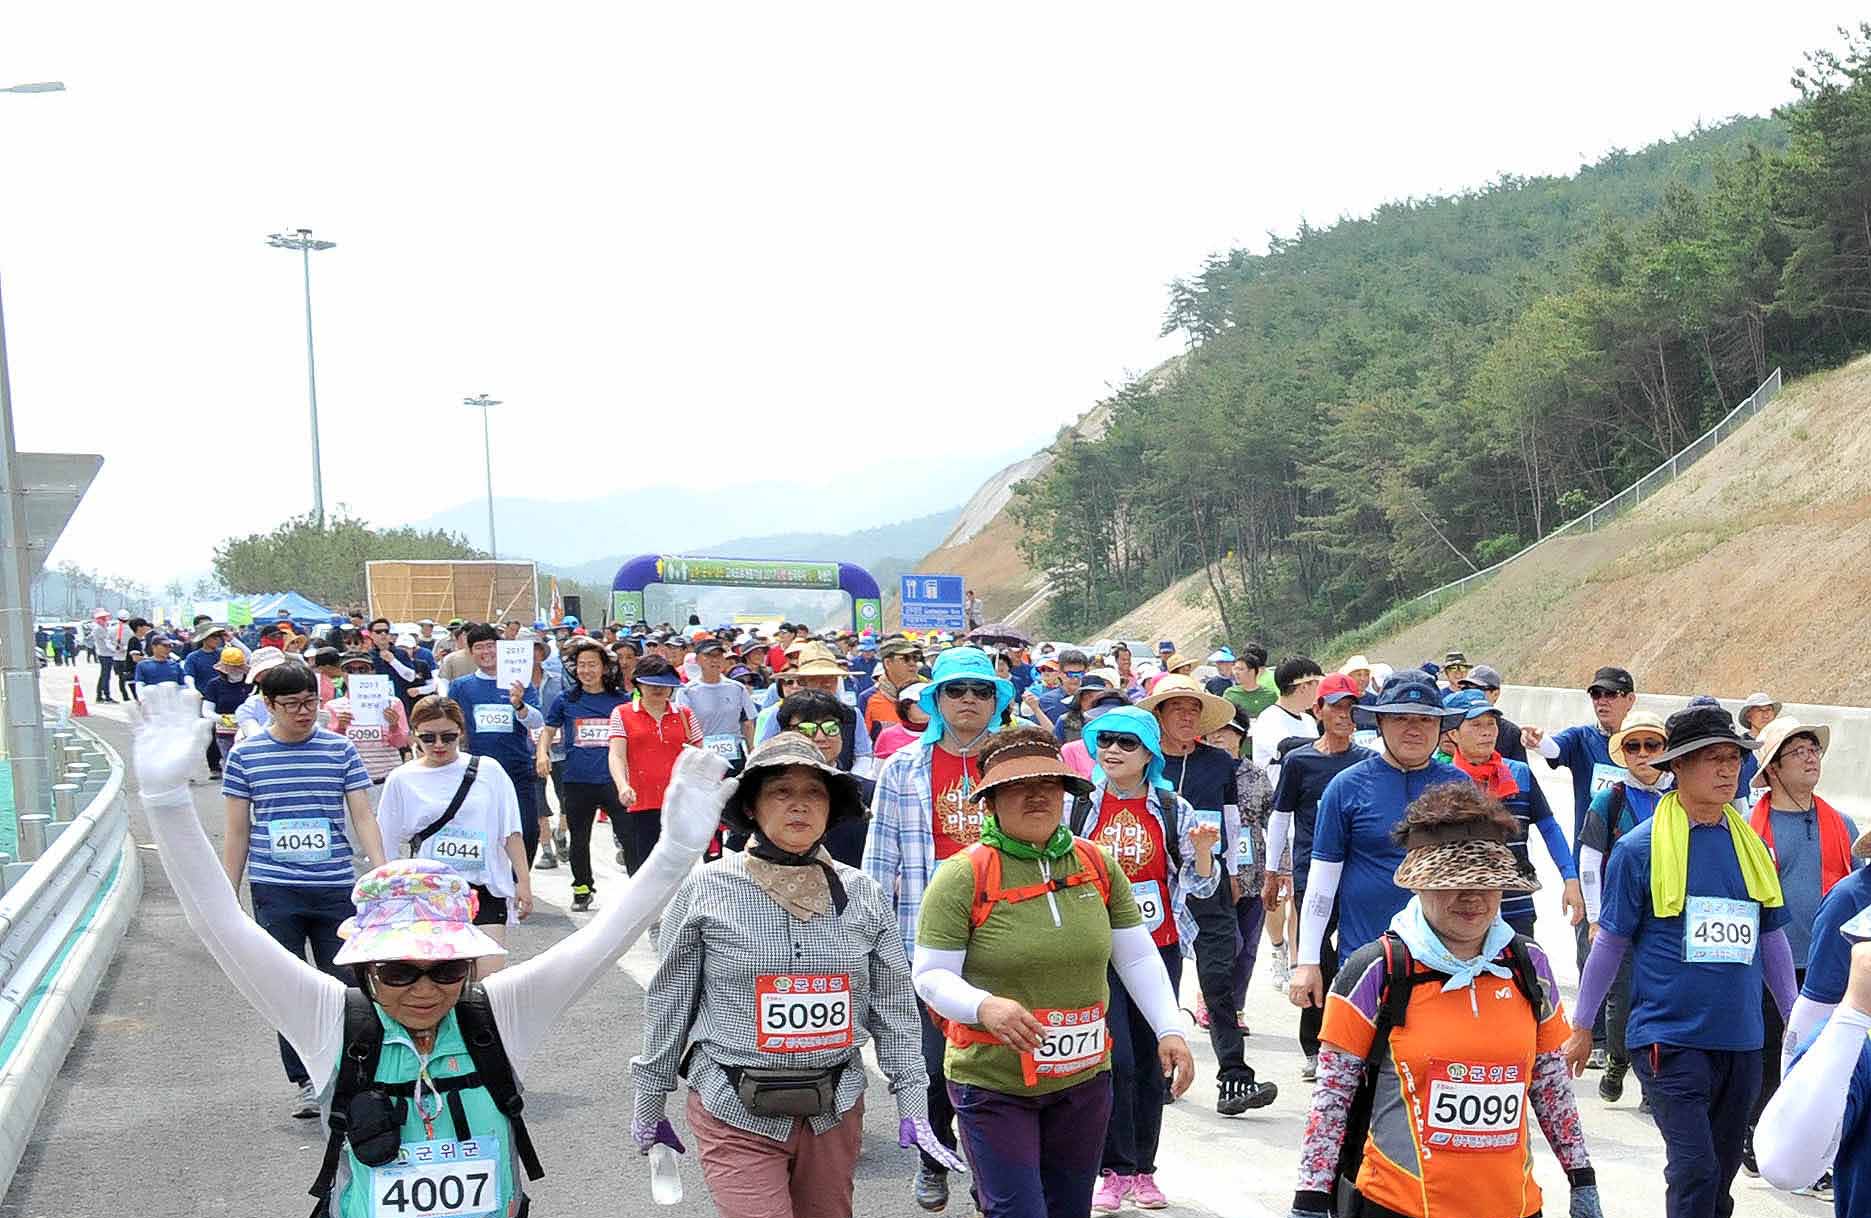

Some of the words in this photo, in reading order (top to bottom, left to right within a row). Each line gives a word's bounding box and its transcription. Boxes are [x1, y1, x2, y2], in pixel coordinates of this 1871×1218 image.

[479, 714, 509, 725] 7052
[347, 726, 380, 740] 5090
[276, 833, 326, 850] 4043
[435, 841, 481, 859] 4044
[1694, 921, 1752, 945] 4309
[766, 1000, 846, 1029] 5098
[1039, 1028, 1100, 1058] 5071
[1469, 1065, 1519, 1082] 군위군
[1434, 1092, 1520, 1126] 5099
[415, 1142, 480, 1162] 군위군
[381, 1172, 490, 1214] 4007
